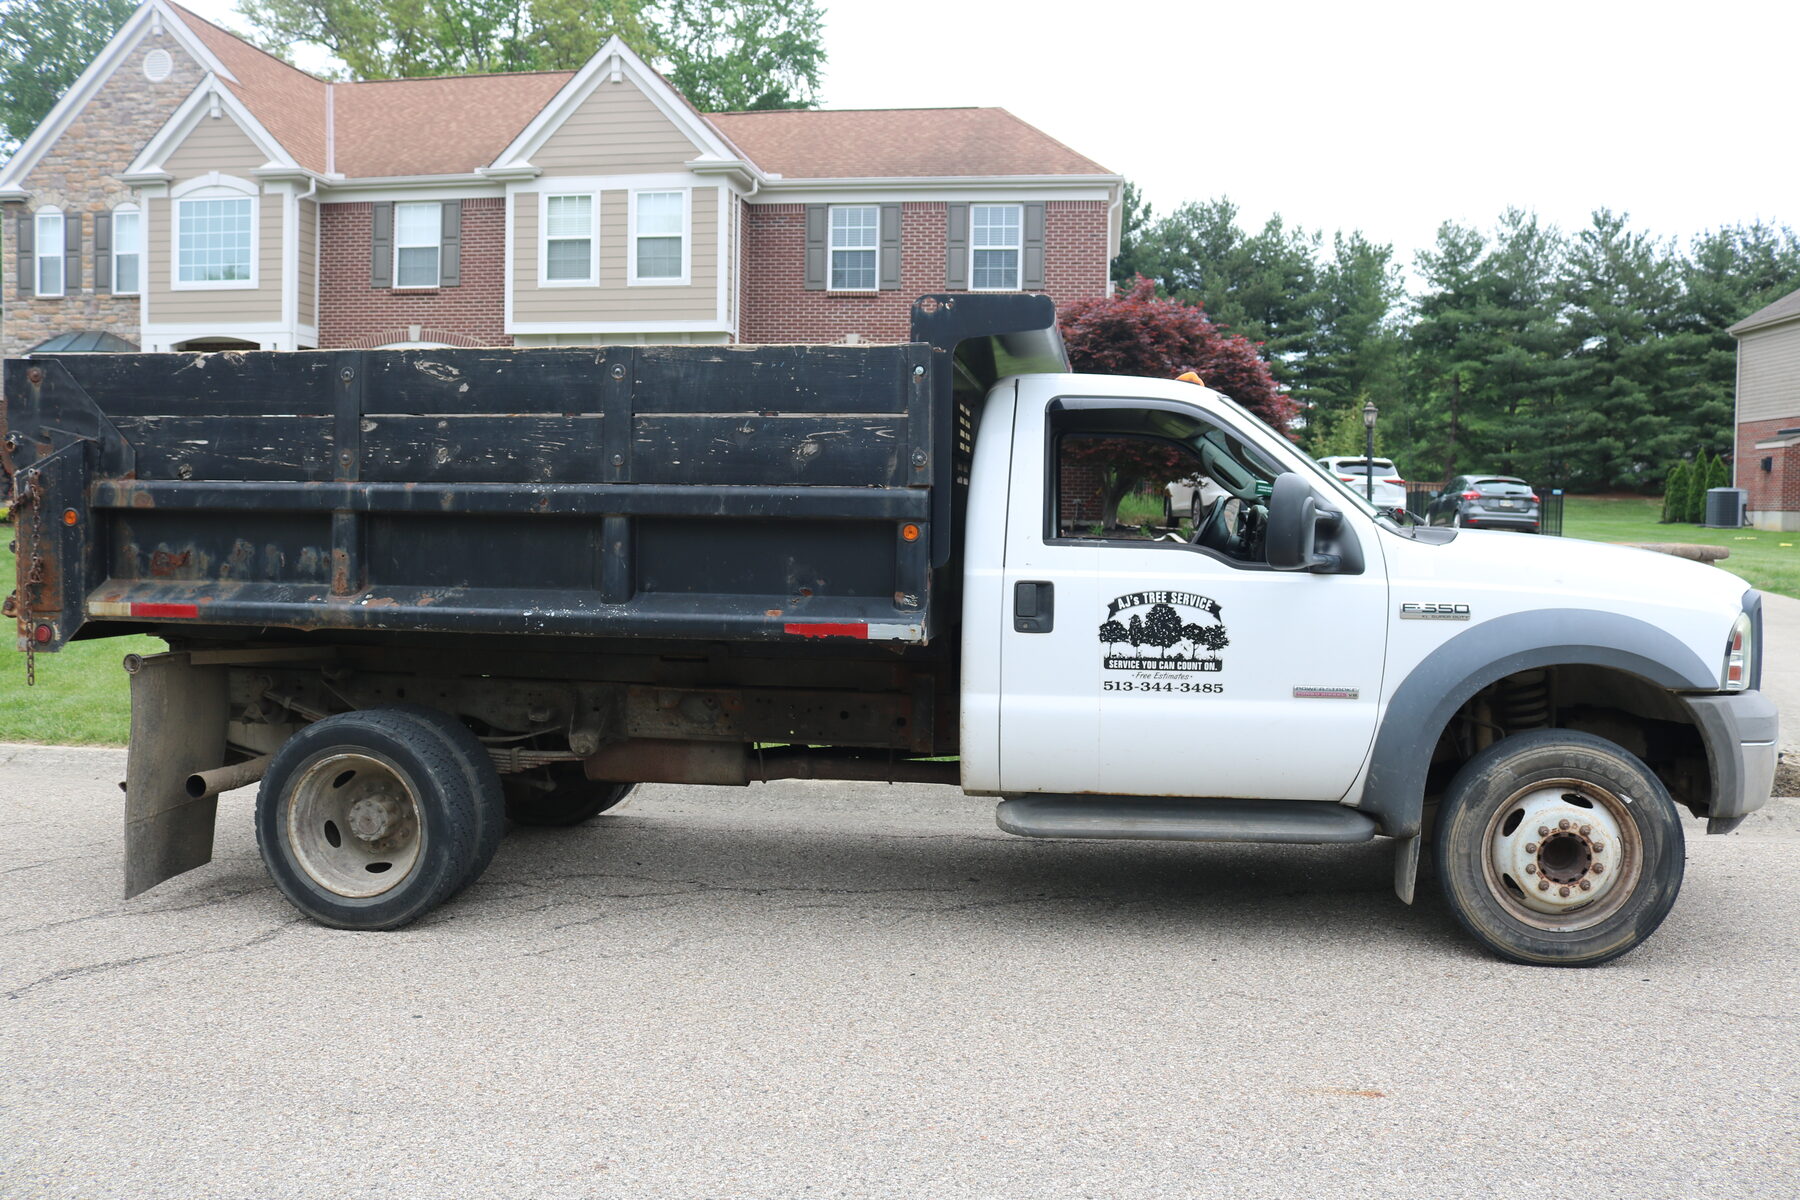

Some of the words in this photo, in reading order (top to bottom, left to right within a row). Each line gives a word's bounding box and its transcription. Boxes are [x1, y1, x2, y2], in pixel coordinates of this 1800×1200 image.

[1117, 596, 1139, 609] AJ's
[1143, 592, 1167, 603] TREE
[1171, 592, 1213, 611] SERVICE
[1108, 660, 1140, 669] SERVICE
[1142, 661, 1157, 670] YOU
[1159, 661, 1175, 670] CAN
[1177, 661, 1202, 671] COUNT
[1204, 662, 1218, 671] ON.
[1103, 681, 1224, 694] 513-344-3485
